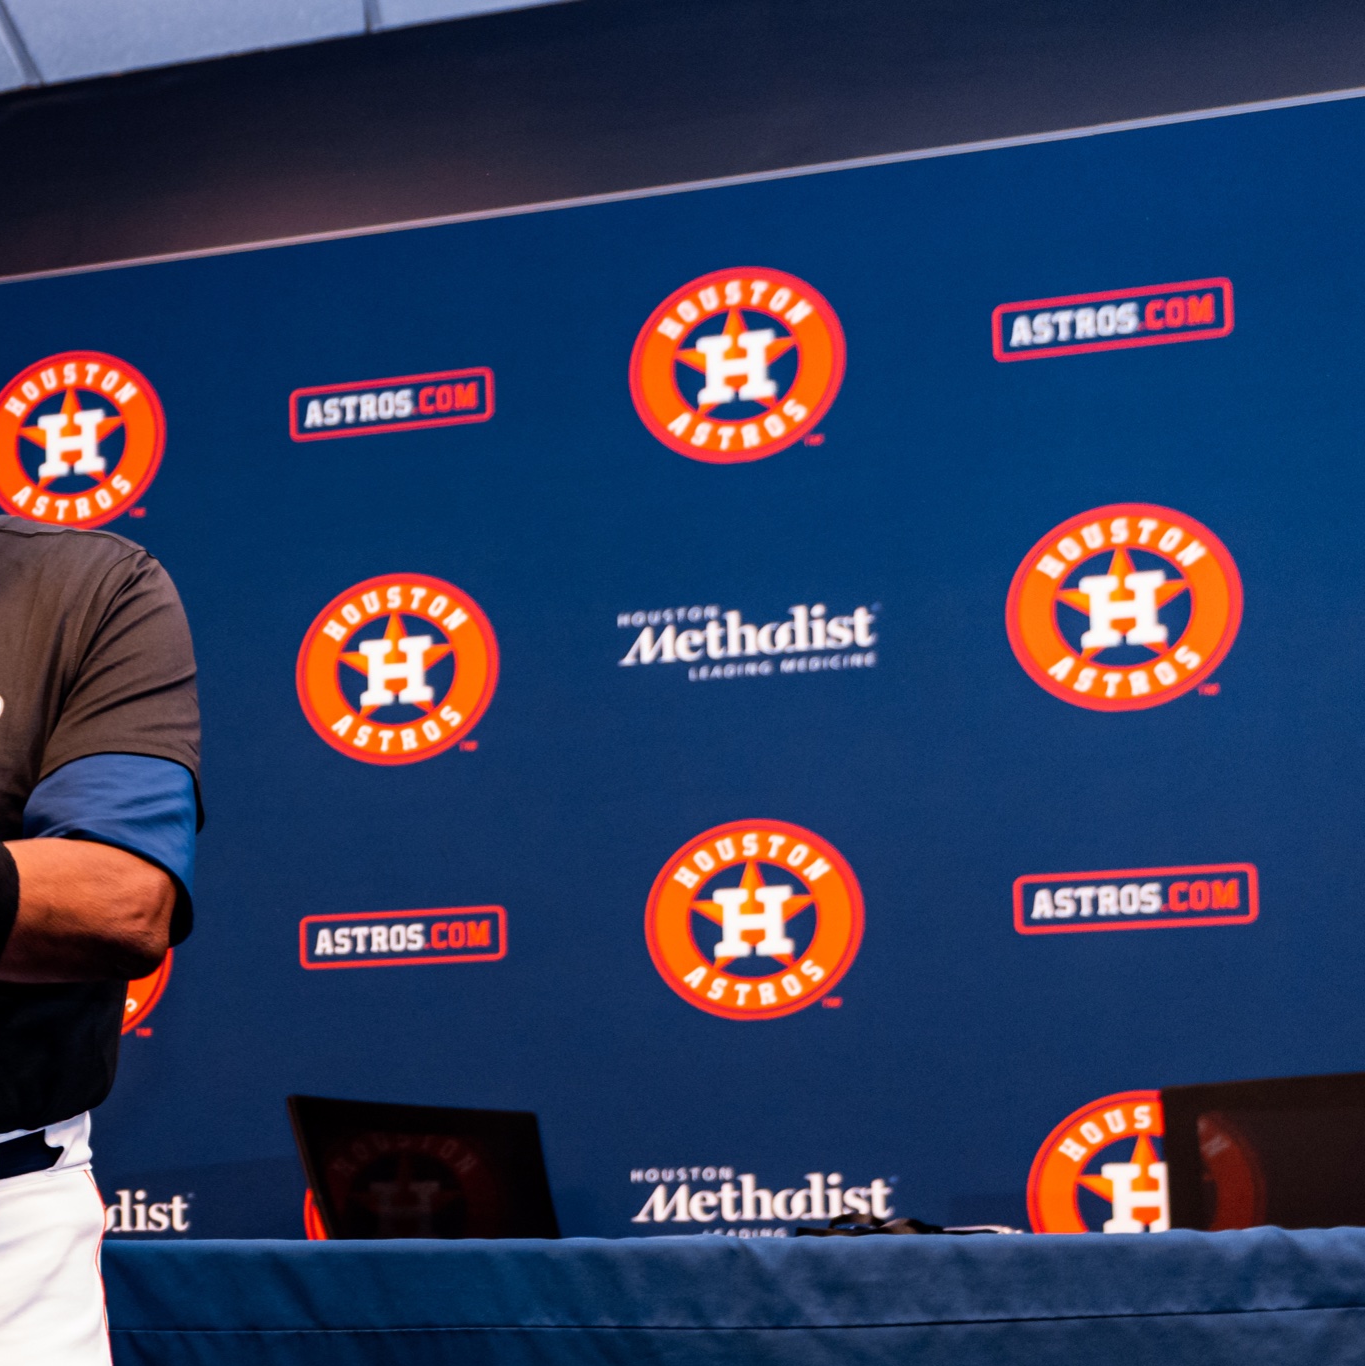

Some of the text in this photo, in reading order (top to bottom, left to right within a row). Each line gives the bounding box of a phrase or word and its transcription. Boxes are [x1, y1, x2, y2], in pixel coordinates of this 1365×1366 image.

[657, 280, 814, 341] HOUSTON
[1010, 293, 1215, 348] ASTROS.COM
[4, 363, 138, 417] HOUSTON
[304, 382, 478, 429] ASTROS.COM
[667, 398, 808, 451] ASTROS
[12, 474, 131, 522] ASTROS
[1035, 517, 1208, 580] HOUSTON
[322, 586, 469, 642] HOUSTON
[617, 605, 720, 628] HOUSTON
[618, 603, 878, 667] Methodist
[688, 651, 877, 682] LEADING MEDICINE
[1047, 645, 1201, 698] ASTROS
[331, 704, 462, 753] ASTROS
[673, 833, 831, 889] HOUSTON
[1031, 878, 1240, 920] ASTROS.COM
[314, 919, 491, 956] ASTROS.COM
[683, 959, 825, 1006] ASTROS
[1057, 1105, 1152, 1162] HOUS
[630, 1166, 734, 1183] HOUSTON
[631, 1172, 894, 1223] Methodist
